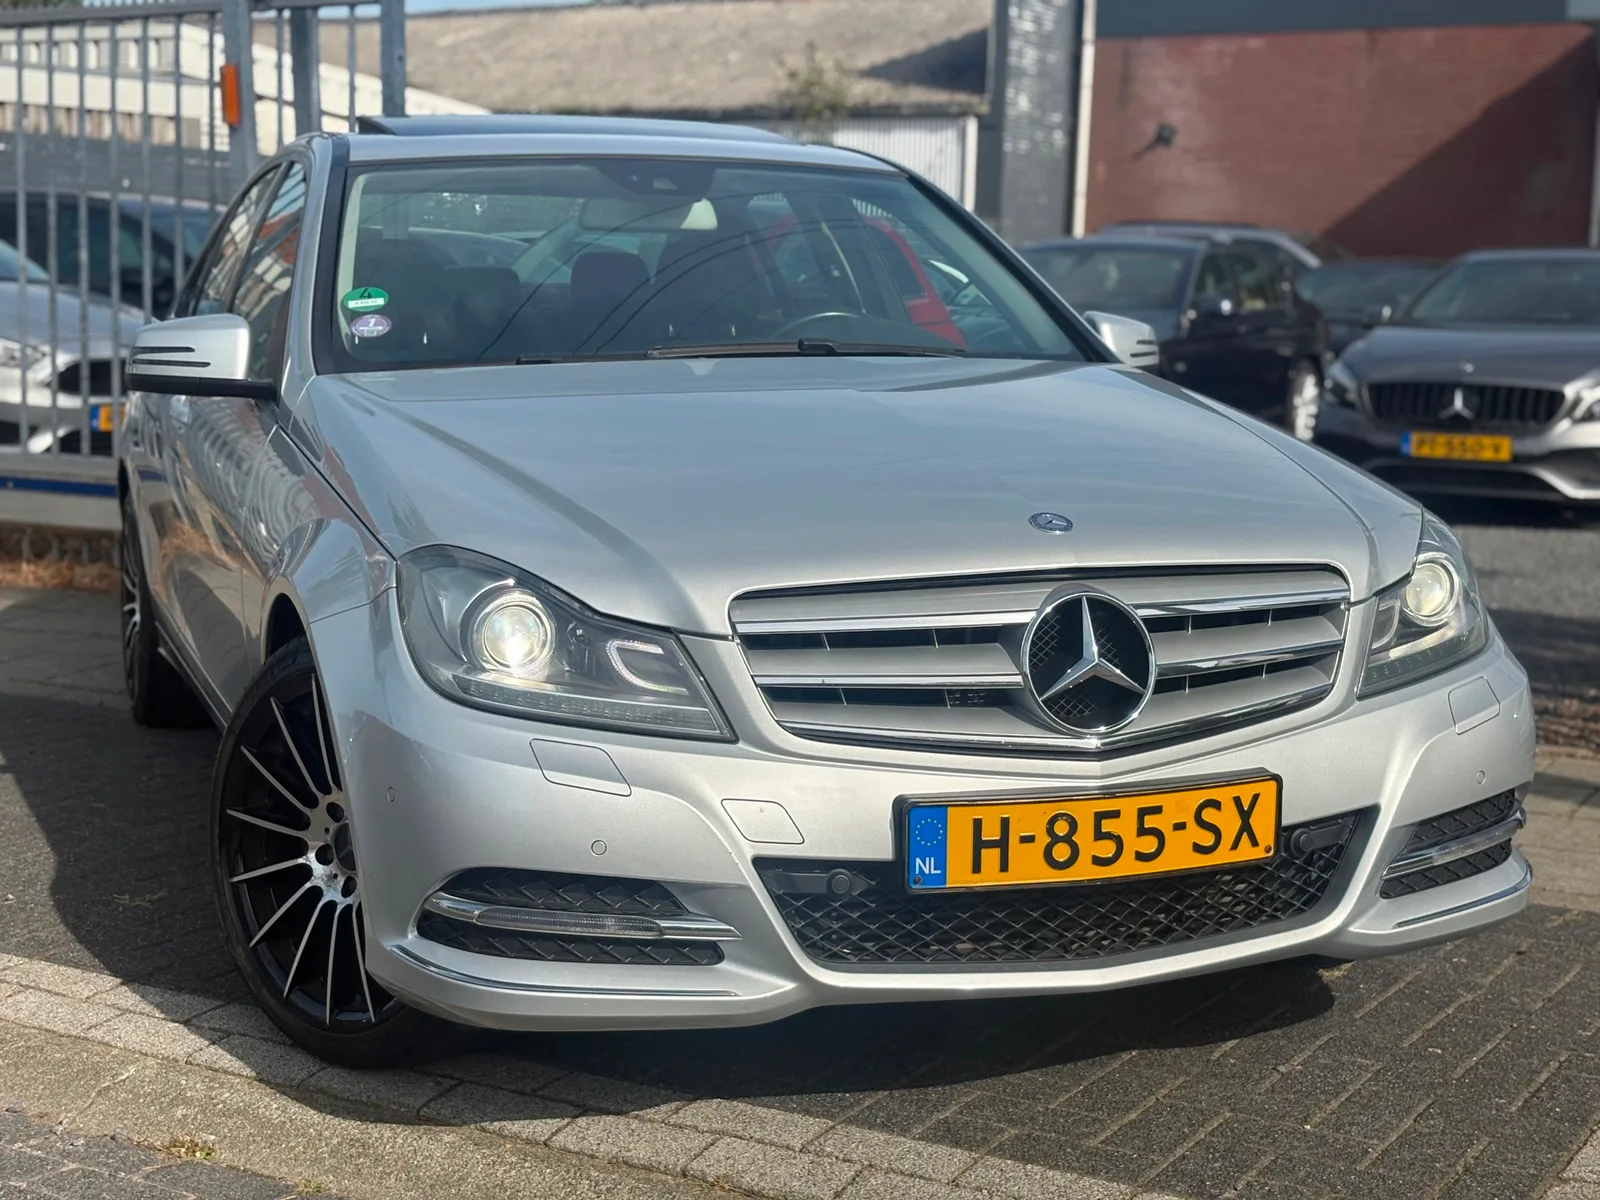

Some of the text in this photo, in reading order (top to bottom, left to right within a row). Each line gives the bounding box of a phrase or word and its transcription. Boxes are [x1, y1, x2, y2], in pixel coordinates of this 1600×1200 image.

[360, 288, 372, 299] 4
[972, 793, 1261, 874] H-855-SX
[915, 857, 941, 874] NL
